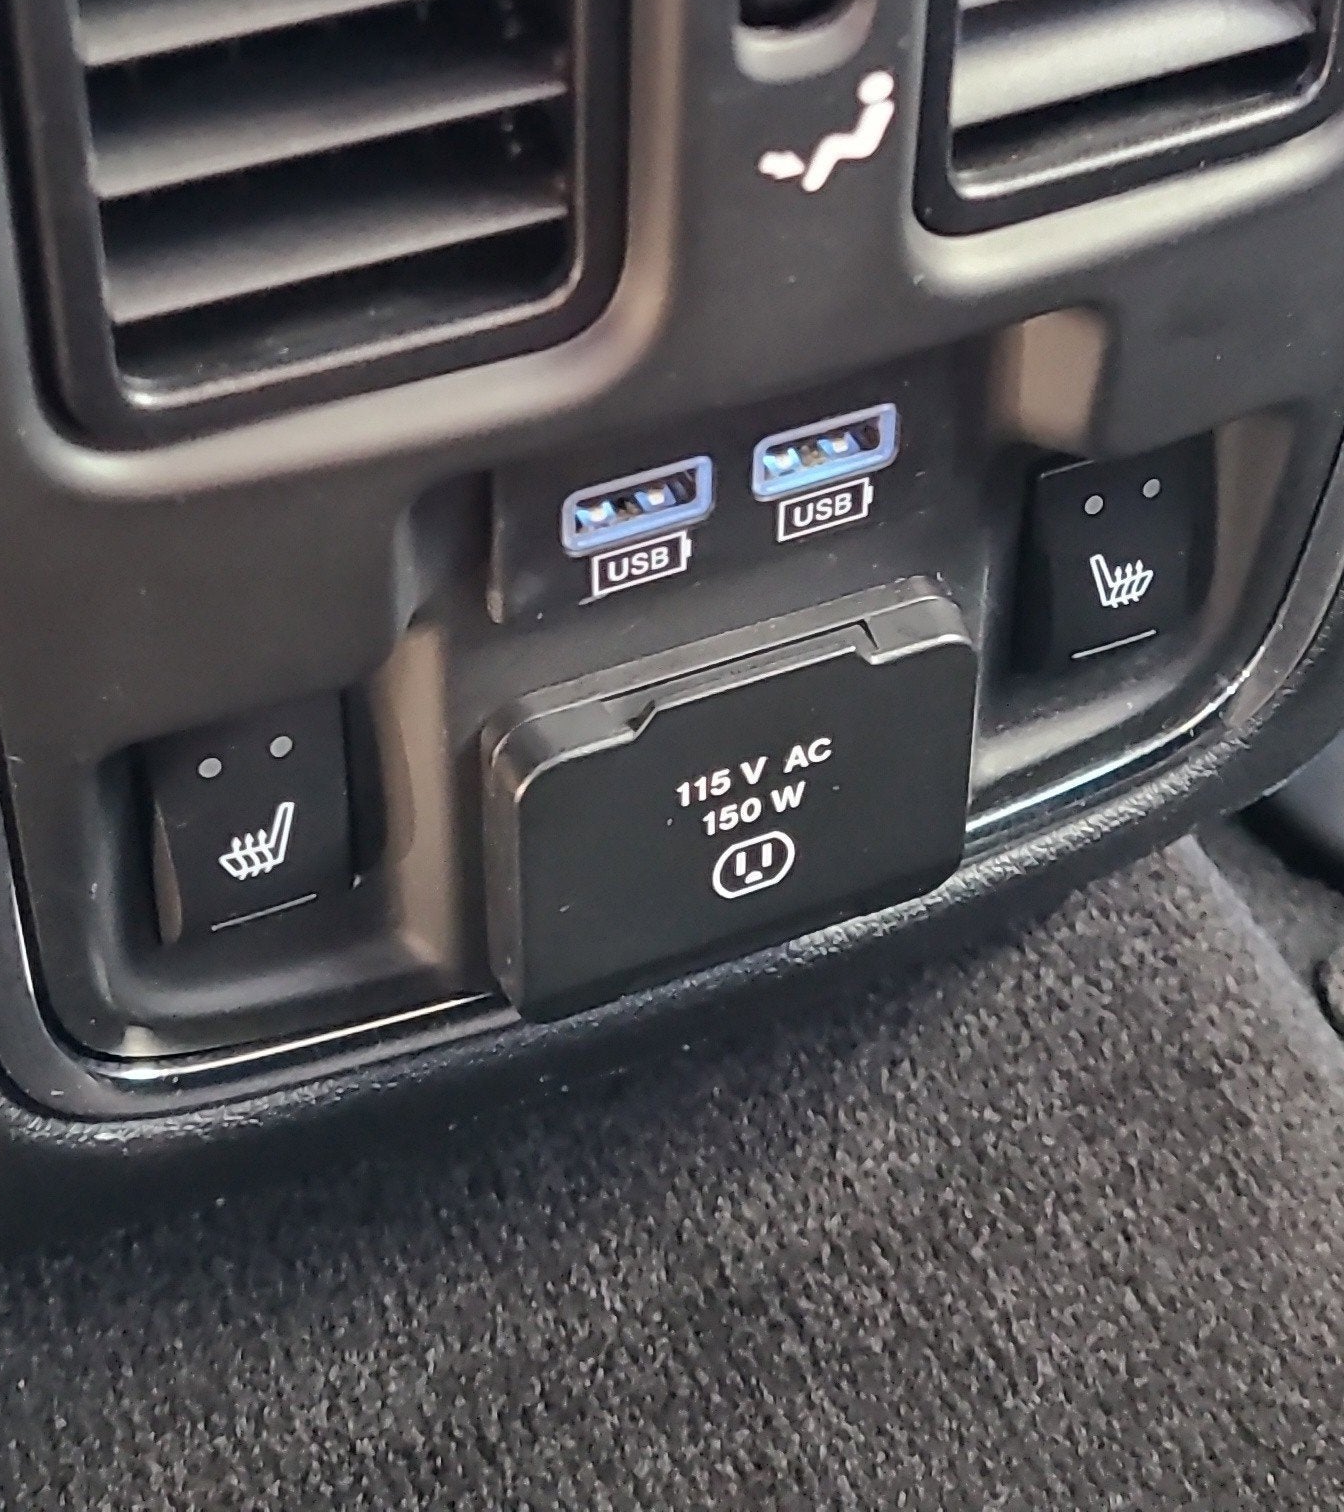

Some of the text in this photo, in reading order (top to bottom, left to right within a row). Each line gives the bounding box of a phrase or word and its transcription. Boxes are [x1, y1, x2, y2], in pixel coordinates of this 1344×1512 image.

[792, 491, 854, 529] USB
[606, 545, 671, 583] USB
[675, 736, 833, 808] 115 V AC
[702, 780, 807, 836] 150 W
